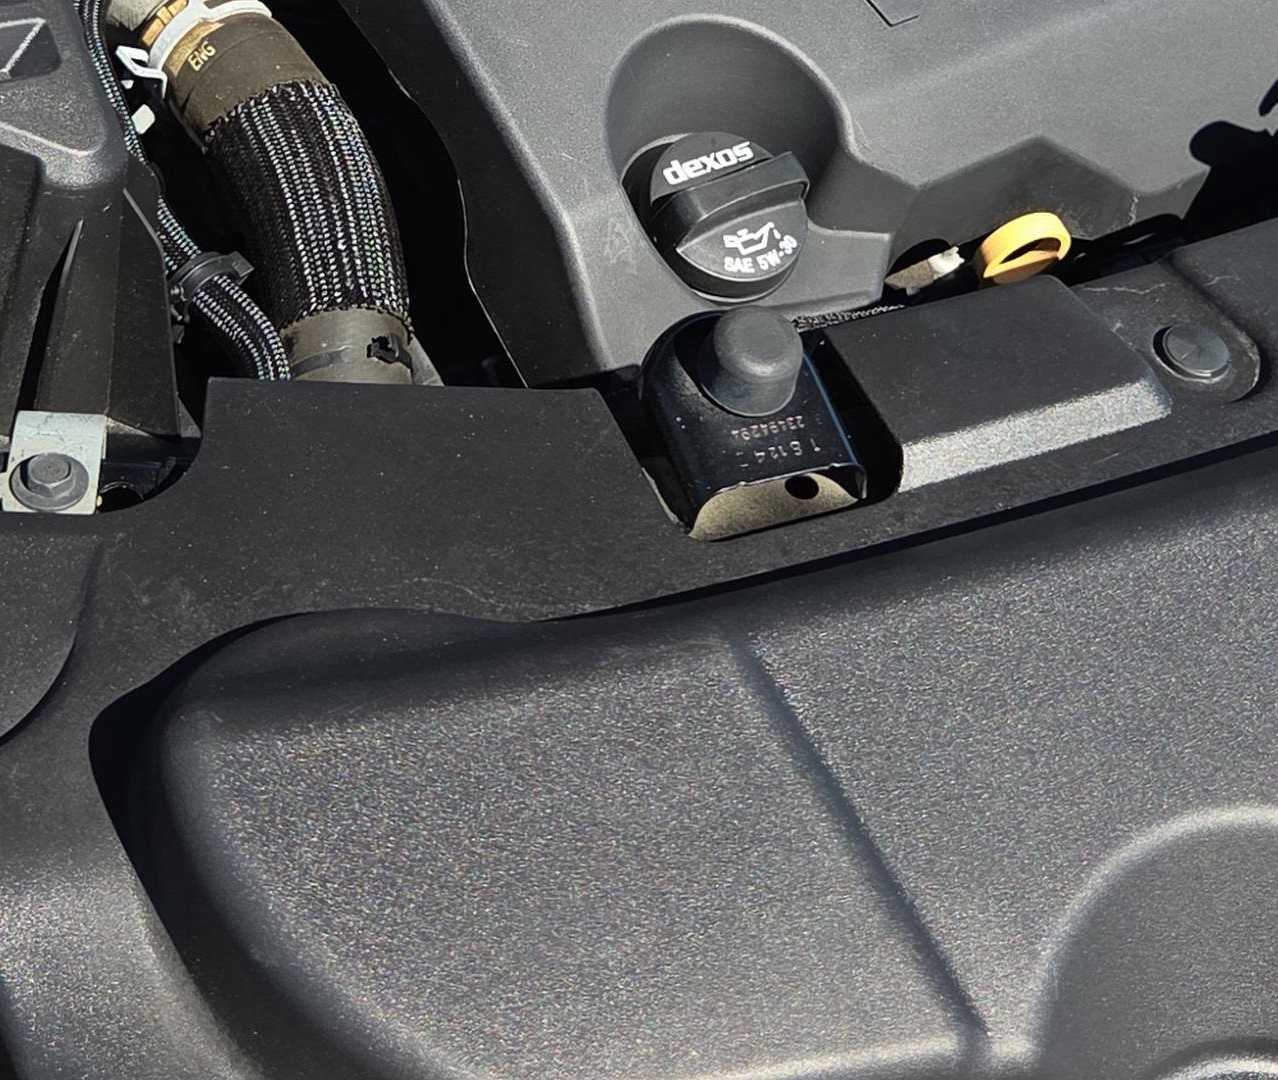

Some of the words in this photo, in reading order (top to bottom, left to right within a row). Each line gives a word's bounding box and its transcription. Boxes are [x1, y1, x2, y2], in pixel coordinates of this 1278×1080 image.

[187, 40, 217, 72] ENG
[662, 140, 755, 186] dexos
[723, 255, 756, 273] SAE
[755, 233, 799, 271] 5W-30
